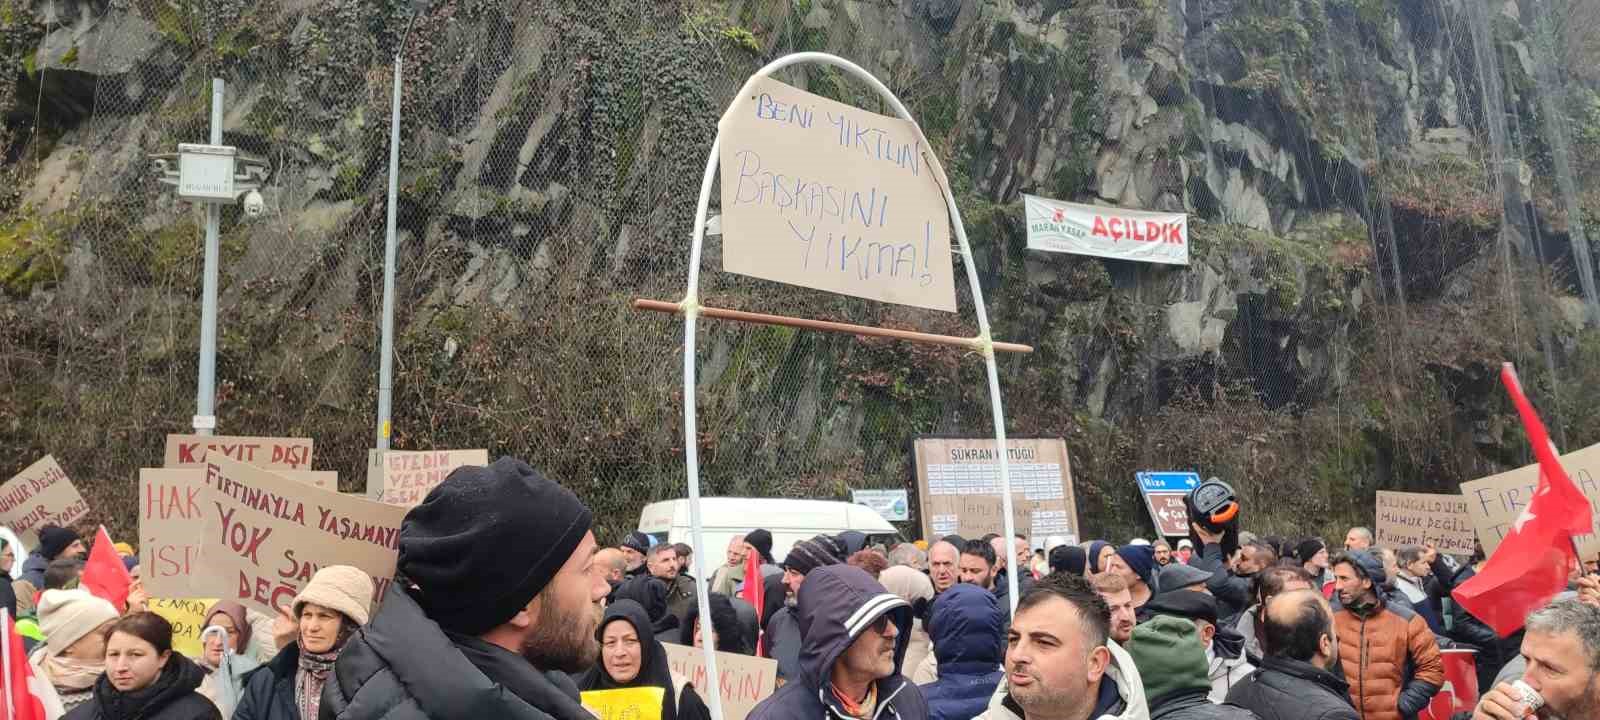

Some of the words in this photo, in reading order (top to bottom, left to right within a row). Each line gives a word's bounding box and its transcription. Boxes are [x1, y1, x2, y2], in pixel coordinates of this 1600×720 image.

[734, 150, 888, 227] BAŞKASINI
[1091, 215, 1184, 243] AÇILDIK
[271, 444, 309, 468] DIŞI
[215, 501, 272, 566] YOK
